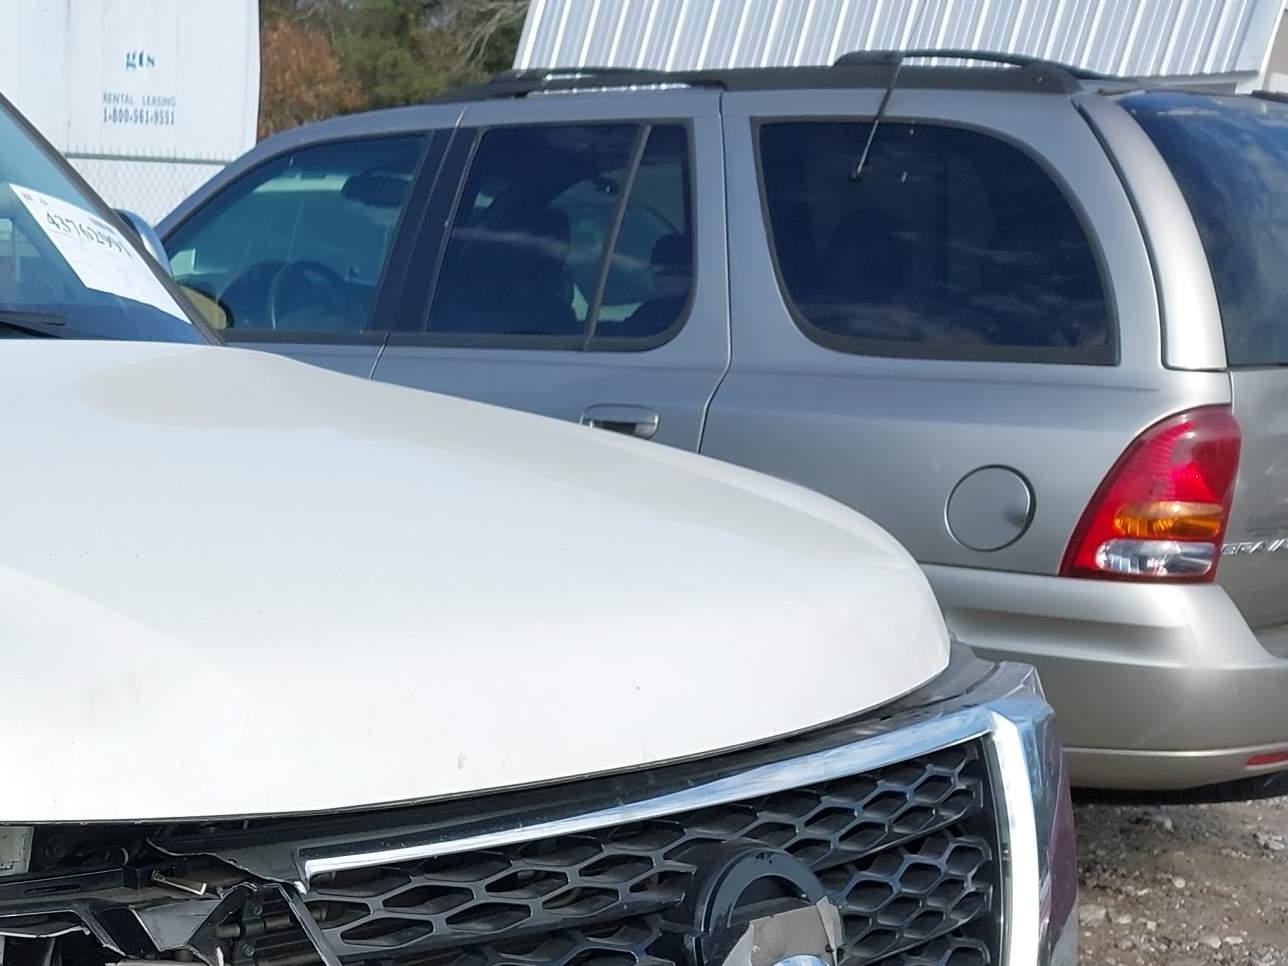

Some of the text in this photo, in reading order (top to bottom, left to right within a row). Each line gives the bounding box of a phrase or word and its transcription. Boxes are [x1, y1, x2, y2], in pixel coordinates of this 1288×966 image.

[125, 50, 155, 70] gts
[103, 92, 176, 107] RENTAL LEASING
